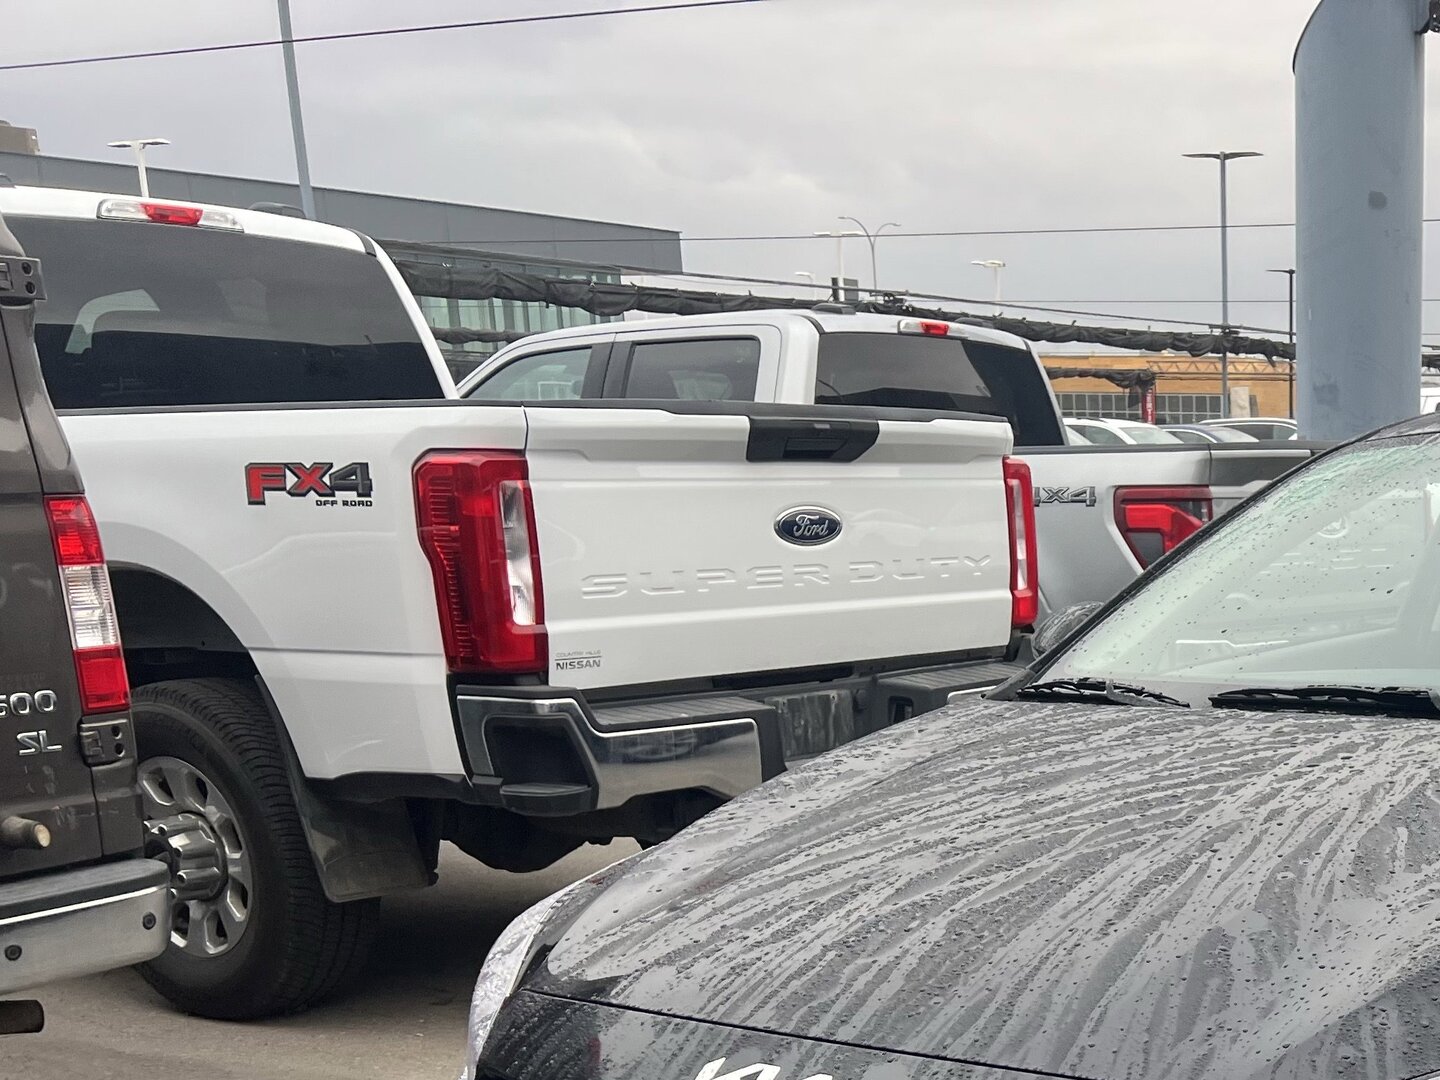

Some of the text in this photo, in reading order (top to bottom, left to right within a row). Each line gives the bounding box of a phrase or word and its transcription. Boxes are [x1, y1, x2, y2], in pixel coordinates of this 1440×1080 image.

[244, 462, 373, 505] FX4
[793, 514, 829, 537] Ford
[582, 554, 992, 599] SUPER DUTY
[556, 659, 601, 670] NISSAN
[16, 730, 62, 756] SL
